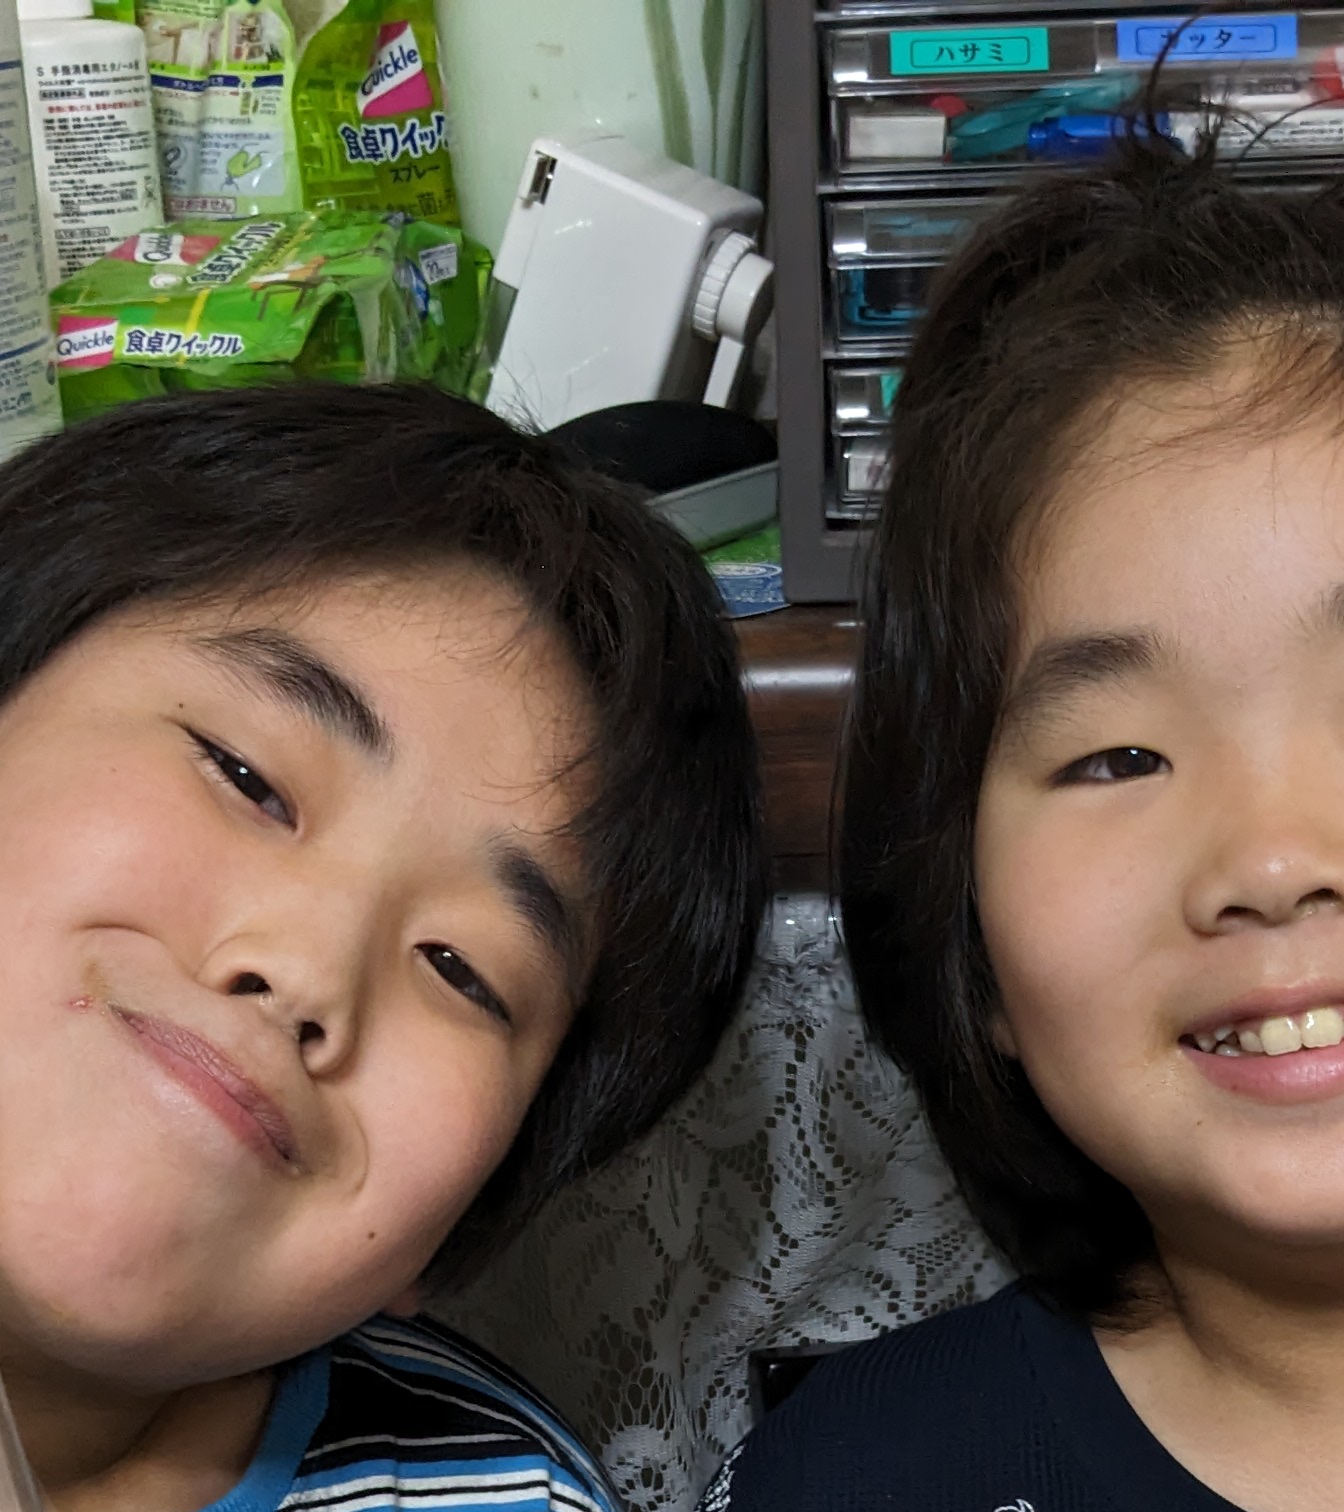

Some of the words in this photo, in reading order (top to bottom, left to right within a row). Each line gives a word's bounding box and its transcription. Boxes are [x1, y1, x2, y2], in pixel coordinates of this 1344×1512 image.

[934, 42, 1005, 63] ハサミ
[57, 330, 115, 357] Quickle
[126, 329, 242, 354] 食卓クイックル
